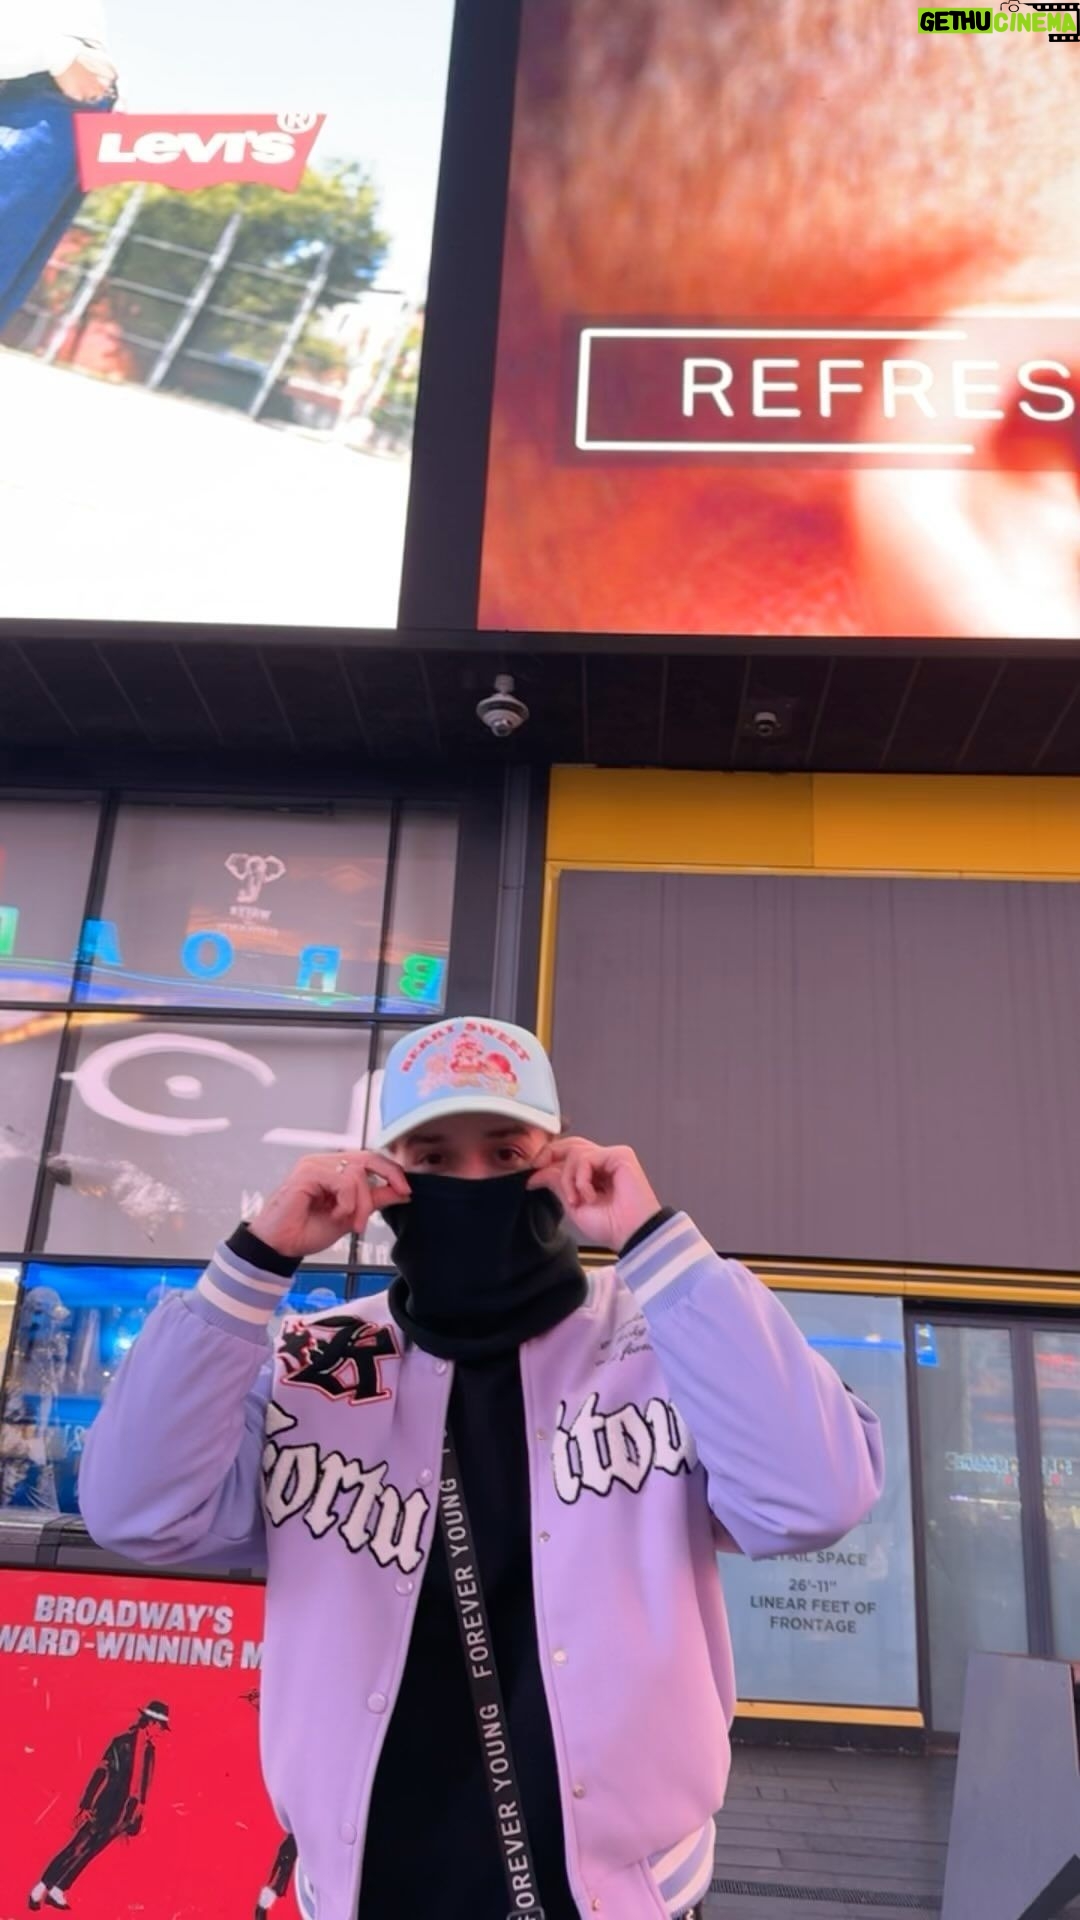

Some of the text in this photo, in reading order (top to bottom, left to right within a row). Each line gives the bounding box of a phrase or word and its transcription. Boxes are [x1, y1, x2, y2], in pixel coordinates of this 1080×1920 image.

[682, 358, 1075, 422] REFRES
[464, 1021, 531, 1062] SWEET
[440, 1478, 469, 1558] YOUNG
[816, 1551, 867, 1567] SPACE
[34, 1594, 234, 1635] BROADWAY'S
[455, 1564, 493, 1679] FOREVER
[750, 1595, 877, 1615] LINEAR FEET OF
[769, 1615, 857, 1634] FRONTAGE
[479, 1703, 513, 1793] YOUNG
